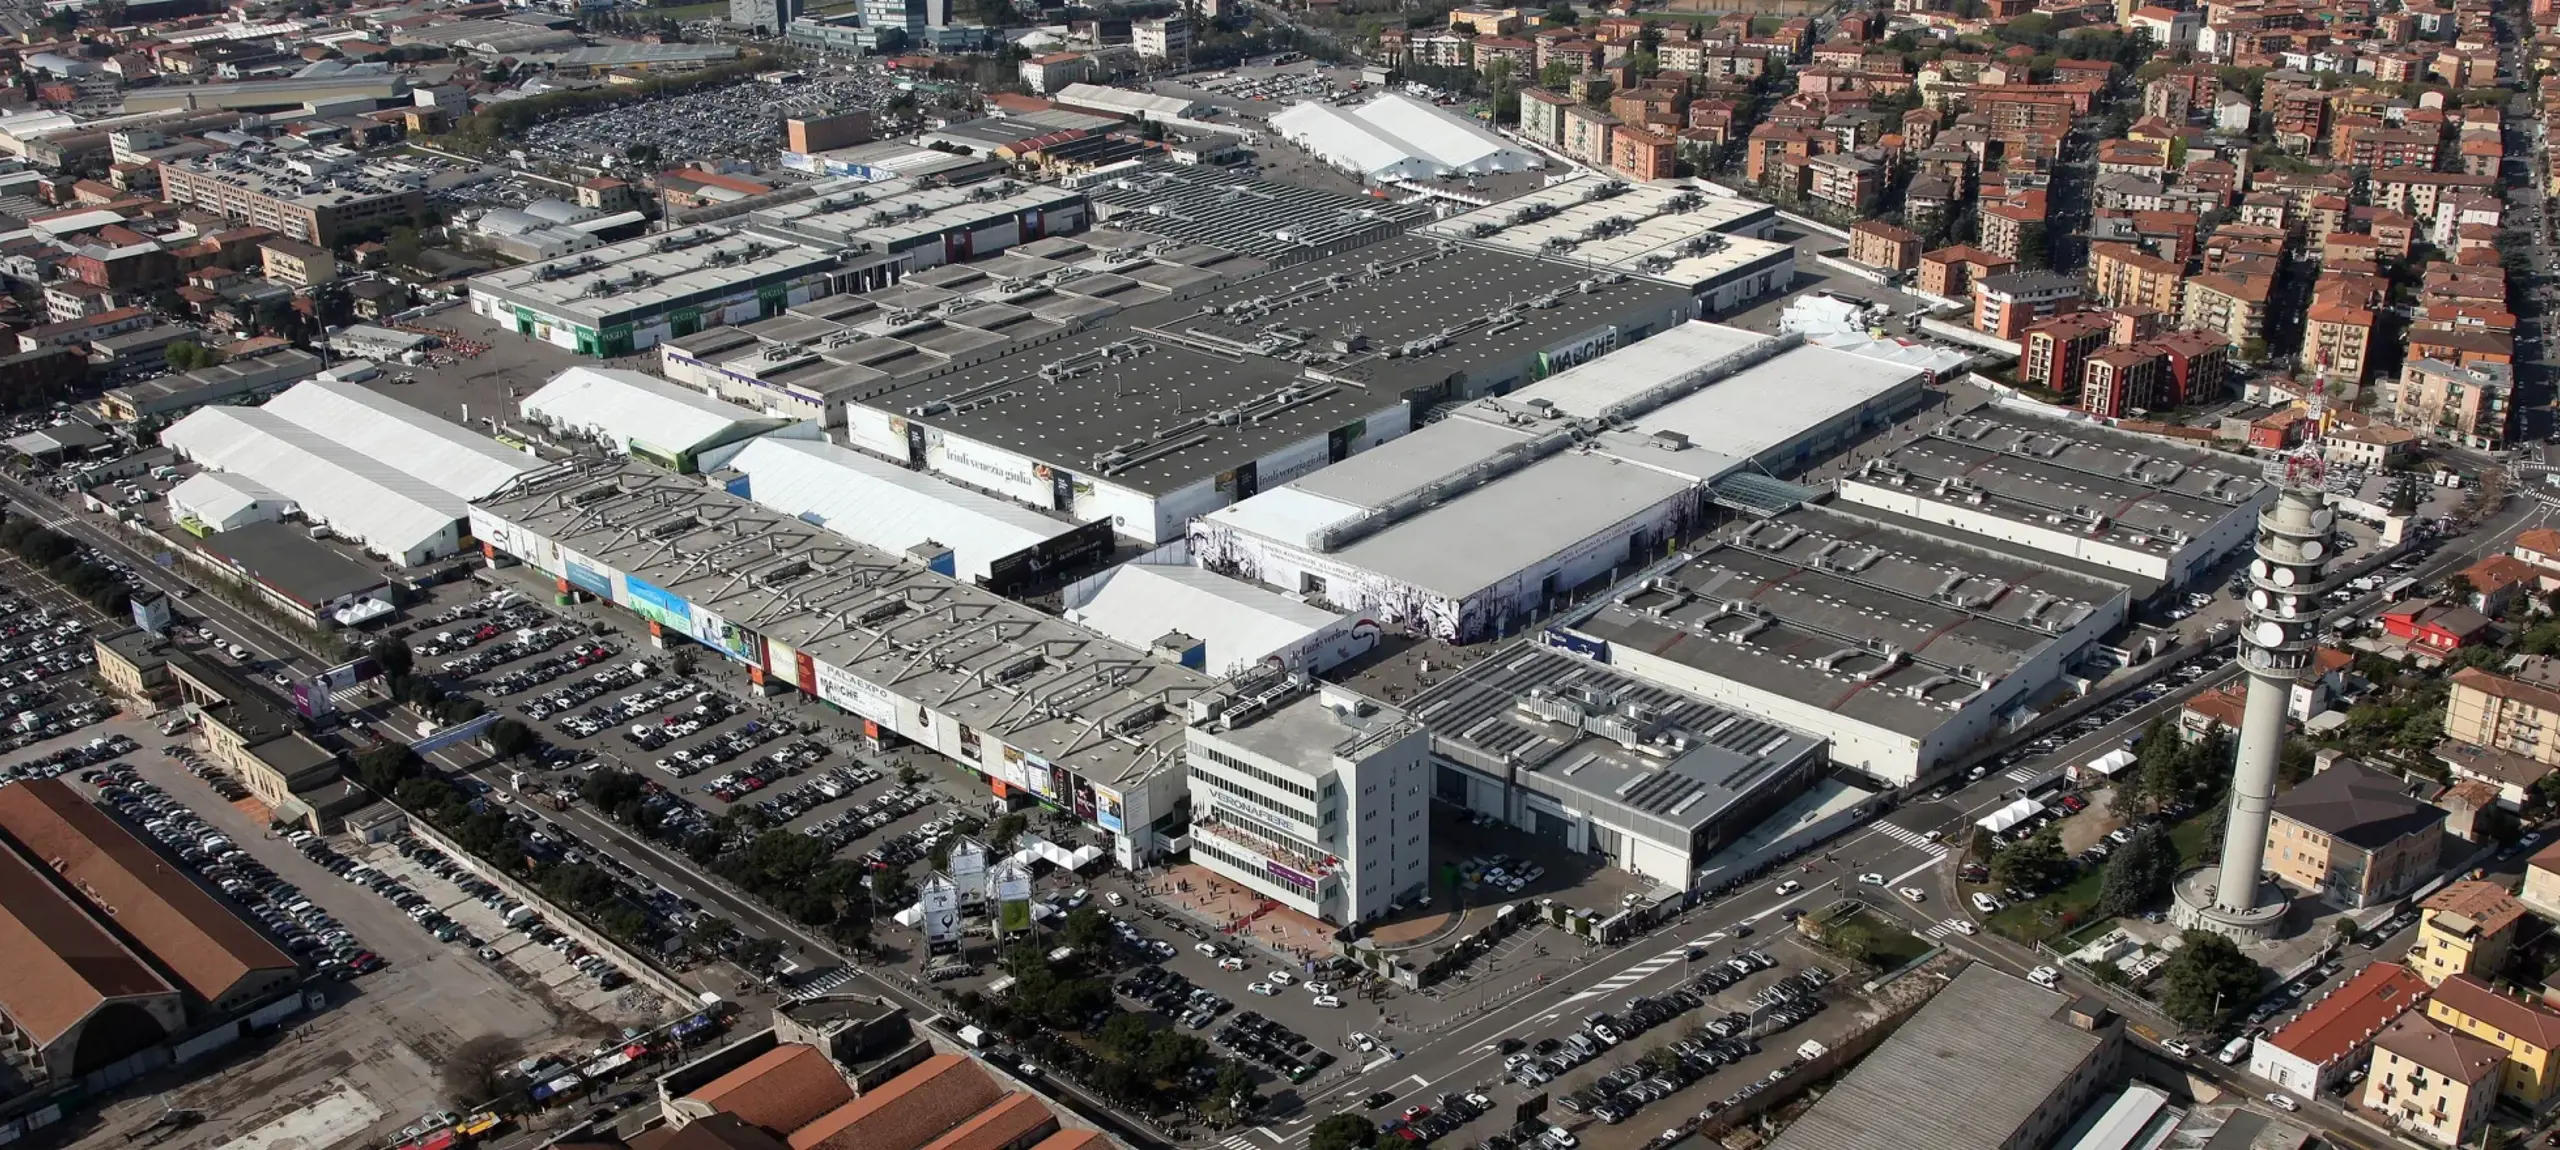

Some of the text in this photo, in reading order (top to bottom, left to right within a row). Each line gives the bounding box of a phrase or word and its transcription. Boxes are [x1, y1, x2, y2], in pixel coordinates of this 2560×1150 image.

[672, 311, 697, 322] PUGLIA
[603, 329, 629, 340] PUGLIA
[970, 459, 1004, 477] venezia
[1005, 467, 1032, 485] giulia
[827, 665, 887, 698] PALAEXPO
[1209, 788, 1294, 831] VERONAFIERE
